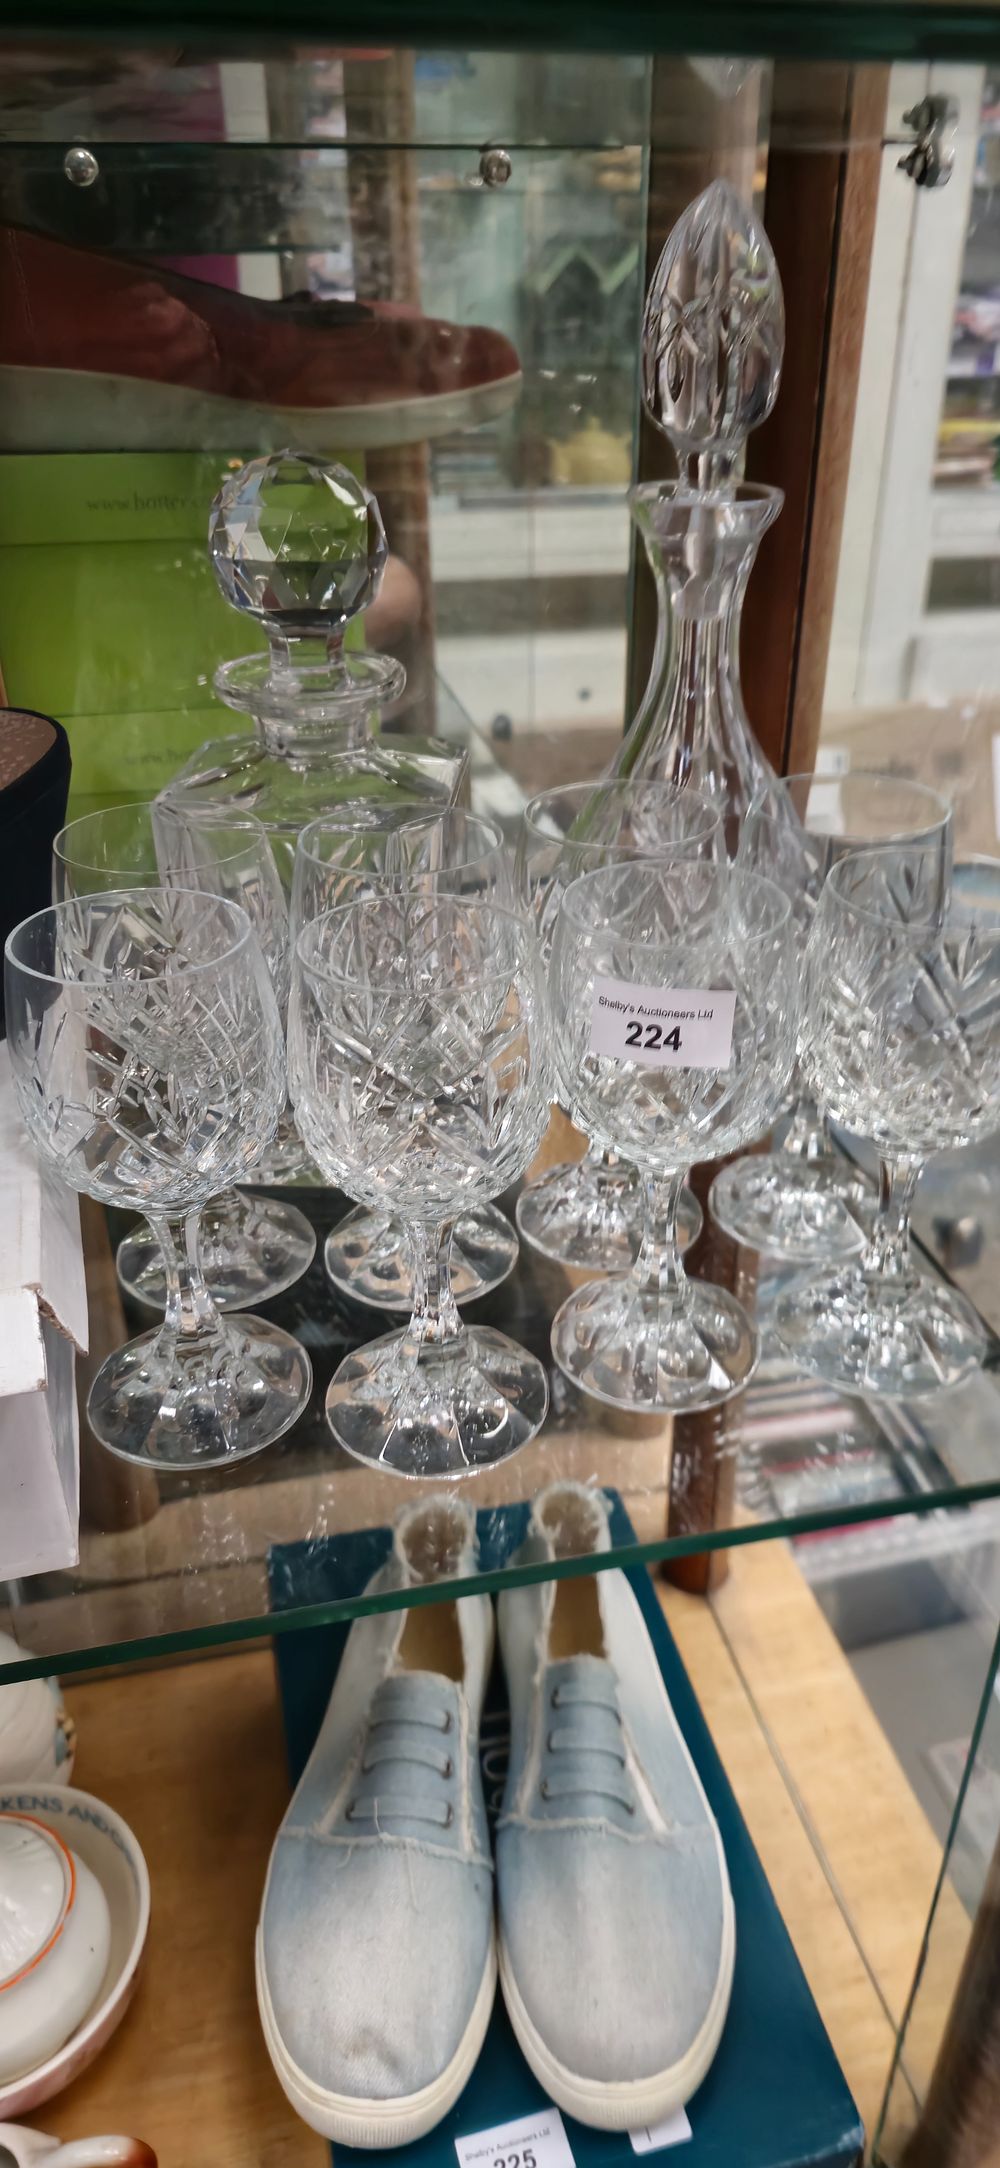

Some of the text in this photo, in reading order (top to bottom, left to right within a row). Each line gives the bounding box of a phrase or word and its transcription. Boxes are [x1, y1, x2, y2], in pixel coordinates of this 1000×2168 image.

[598, 995, 714, 1021] Shelby's Auctioneers Ltd
[624, 1020, 683, 1052] 224
[67, 1803, 109, 1833] AND
[465, 2127, 551, 2161] Shelby's Auctioneers Ltd
